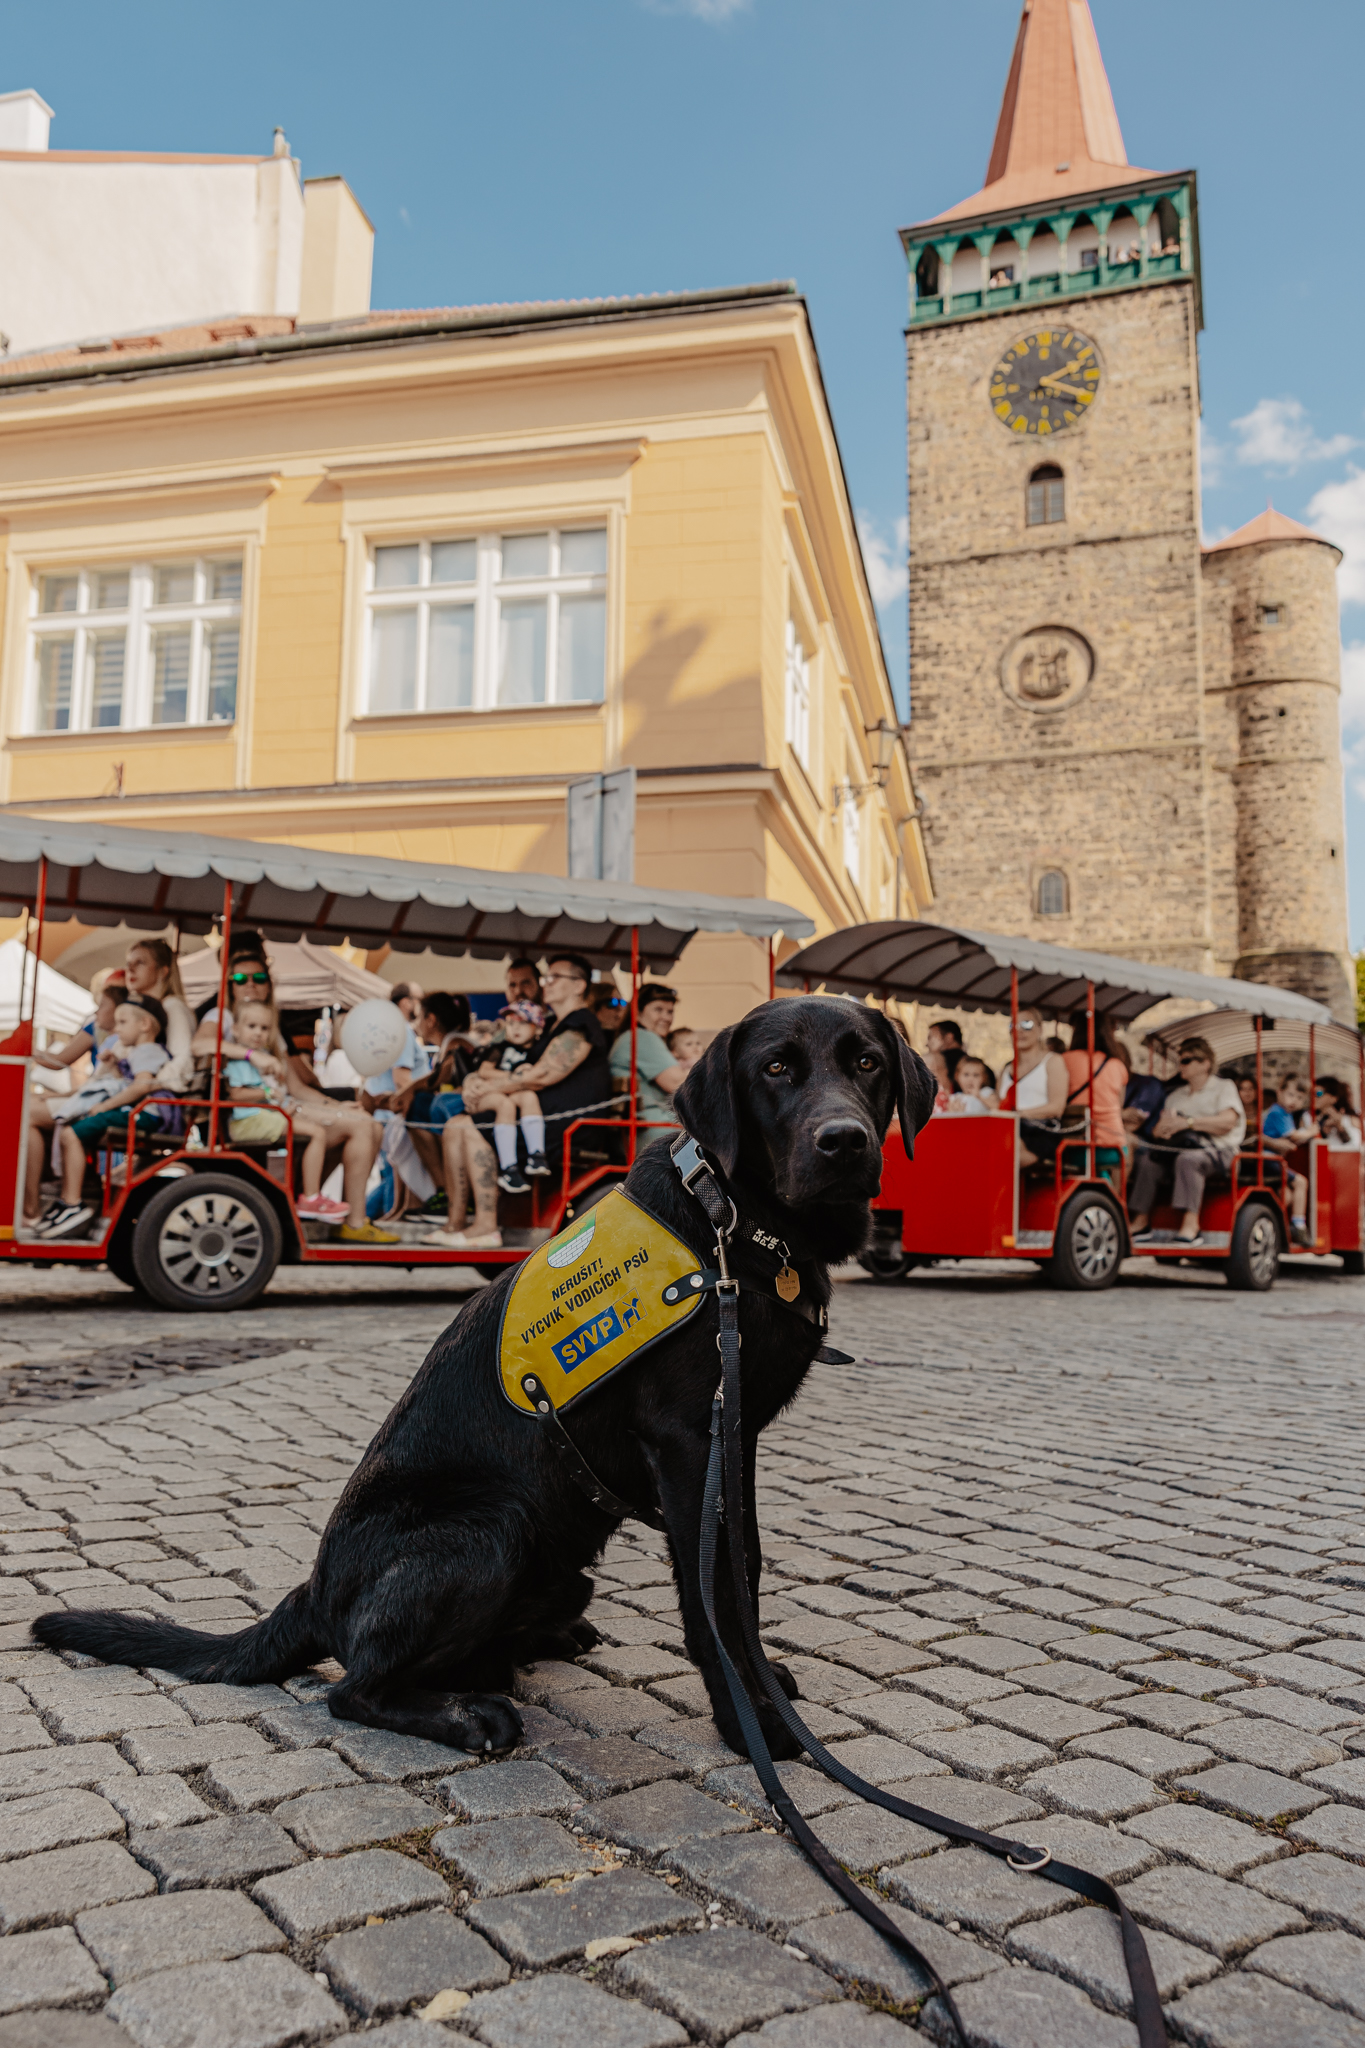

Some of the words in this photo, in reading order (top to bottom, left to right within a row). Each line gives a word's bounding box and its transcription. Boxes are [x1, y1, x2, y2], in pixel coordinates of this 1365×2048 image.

[521, 1306, 564, 1344] VÝCVIK
[564, 1267, 622, 1312] VODICÍCH
[623, 1247, 649, 1273] PSŮ
[551, 1257, 604, 1301] NERUŠIT!
[561, 1316, 613, 1364] SVVP
